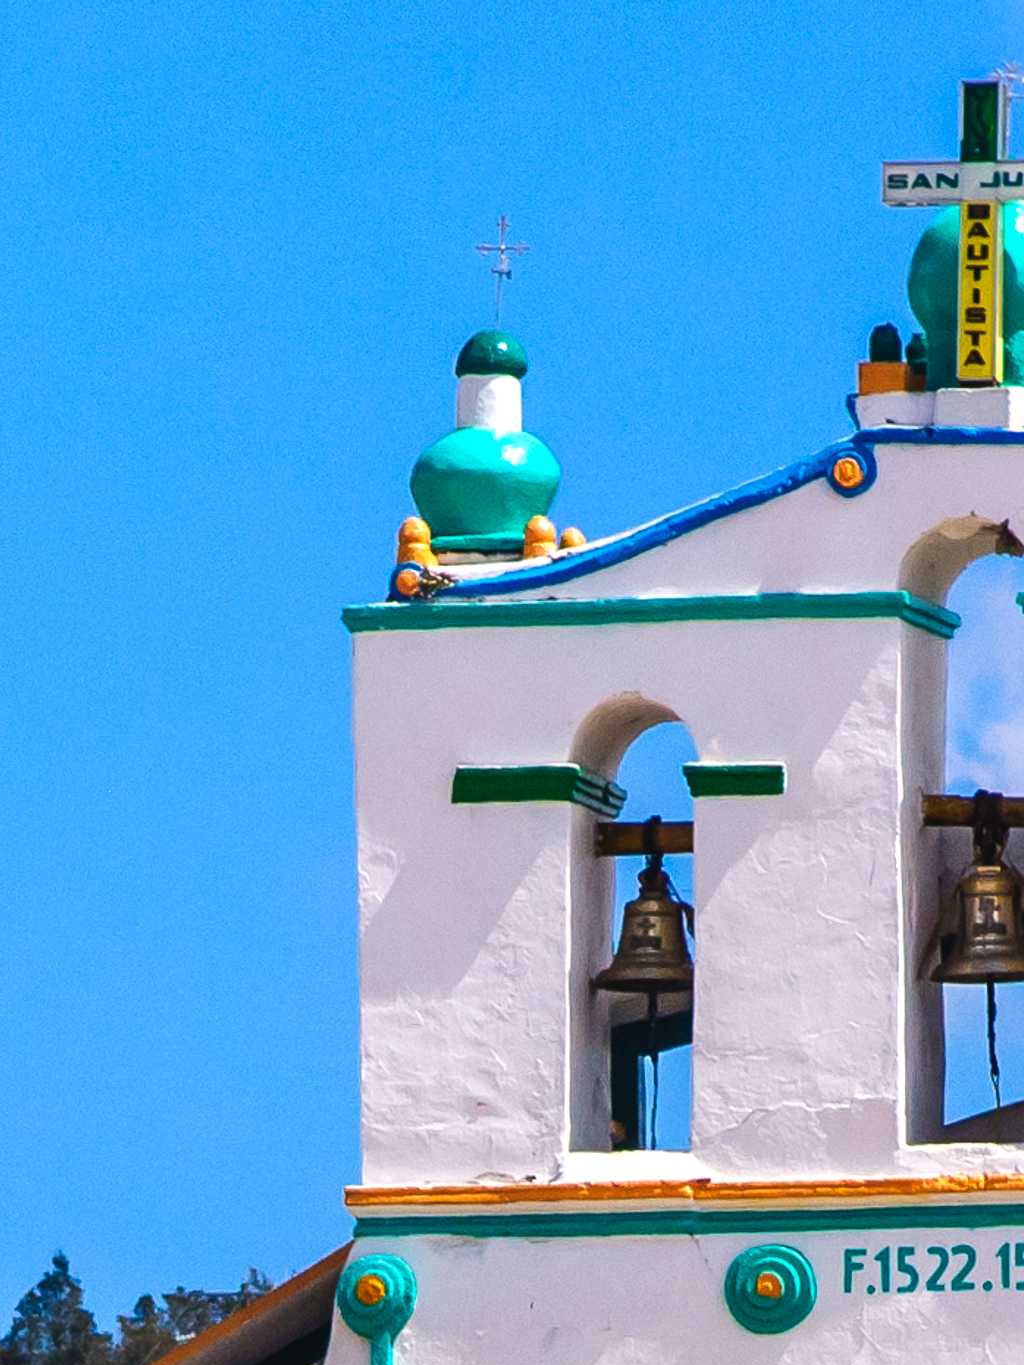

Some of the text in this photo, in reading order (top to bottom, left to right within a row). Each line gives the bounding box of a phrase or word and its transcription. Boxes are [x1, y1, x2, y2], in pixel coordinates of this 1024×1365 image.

[887, 170, 1024, 190] SAN JU
[964, 204, 990, 366] BAUTISTA
